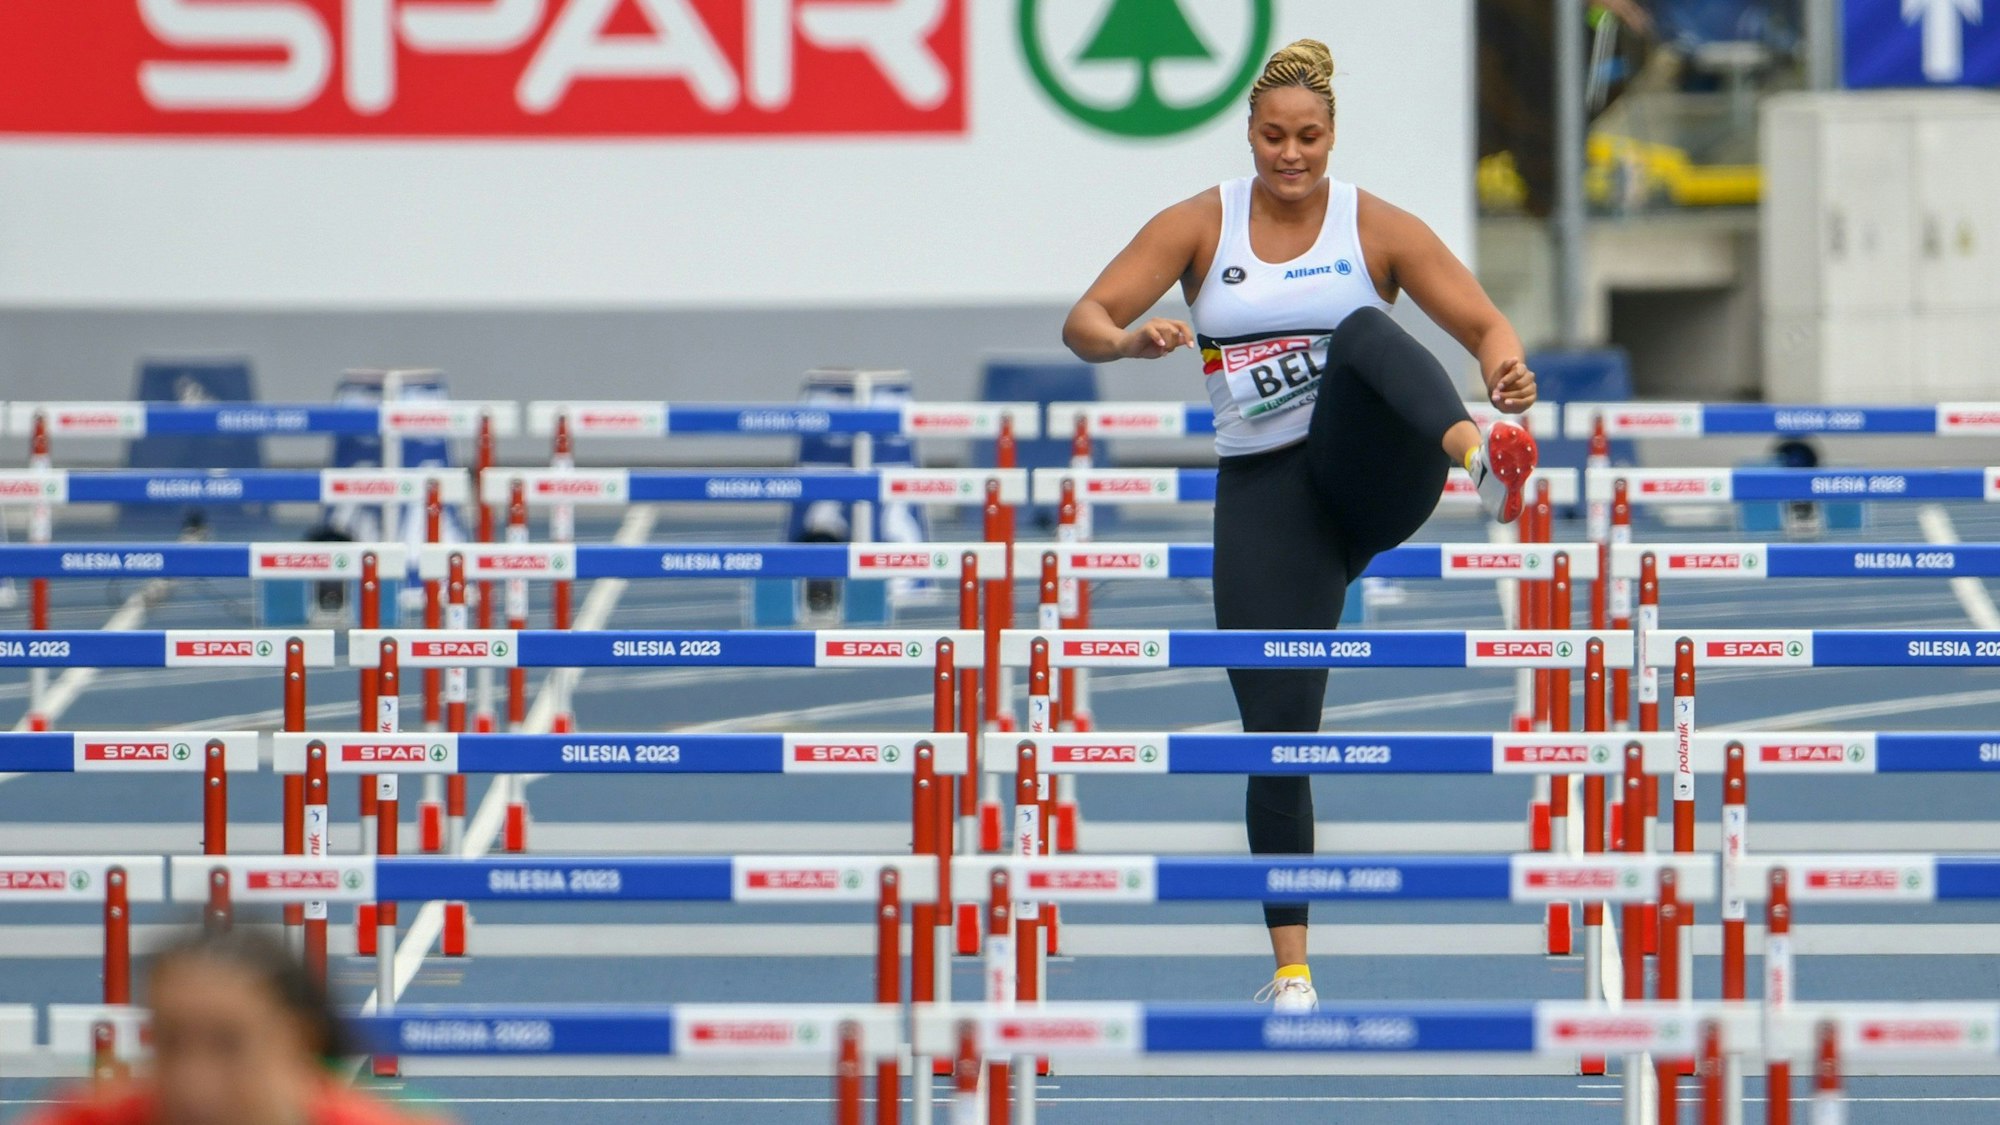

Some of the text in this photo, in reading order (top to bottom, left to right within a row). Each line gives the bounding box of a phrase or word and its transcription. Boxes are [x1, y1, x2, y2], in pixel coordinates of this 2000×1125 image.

[138, 0, 950, 112] SPAR
[1284, 265, 1332, 280] Allianz
[1250, 350, 1324, 398] BEL
[61, 553, 164, 570] SILESIA 2023
[661, 553, 763, 570] SILESIA 2023
[875, 554, 931, 568] SPAR
[1086, 555, 1141, 568] SPAR
[1467, 555, 1522, 568] SPAR
[1684, 555, 1739, 568] SPAR
[1854, 552, 1954, 568] SILESIA 2023
[29, 641, 70, 657] 2023
[193, 642, 252, 655] SPAR
[428, 643, 487, 656] SPAR
[612, 641, 721, 656] SILESIA 2023
[843, 643, 902, 656] SPAR
[1080, 642, 1139, 655] SPAR
[1264, 641, 1371, 657] SILESIA 2023
[1493, 643, 1552, 656] SPAR
[1723, 643, 1782, 655] SPAR
[1908, 641, 1971, 656] SILESIA
[104, 745, 168, 759] SPAR
[360, 746, 425, 760] SPAR
[562, 745, 680, 762] SILESIA 2023
[812, 746, 877, 760] SPAR
[1070, 747, 1136, 760] SPAR
[1271, 746, 1391, 763] SILESIA 2023
[1523, 747, 1587, 761] SPAR
[1677, 722, 1691, 774] polanik
[1778, 747, 1843, 761] SPAR
[266, 871, 338, 889] SPAR
[489, 869, 620, 891] SILESIA 2023
